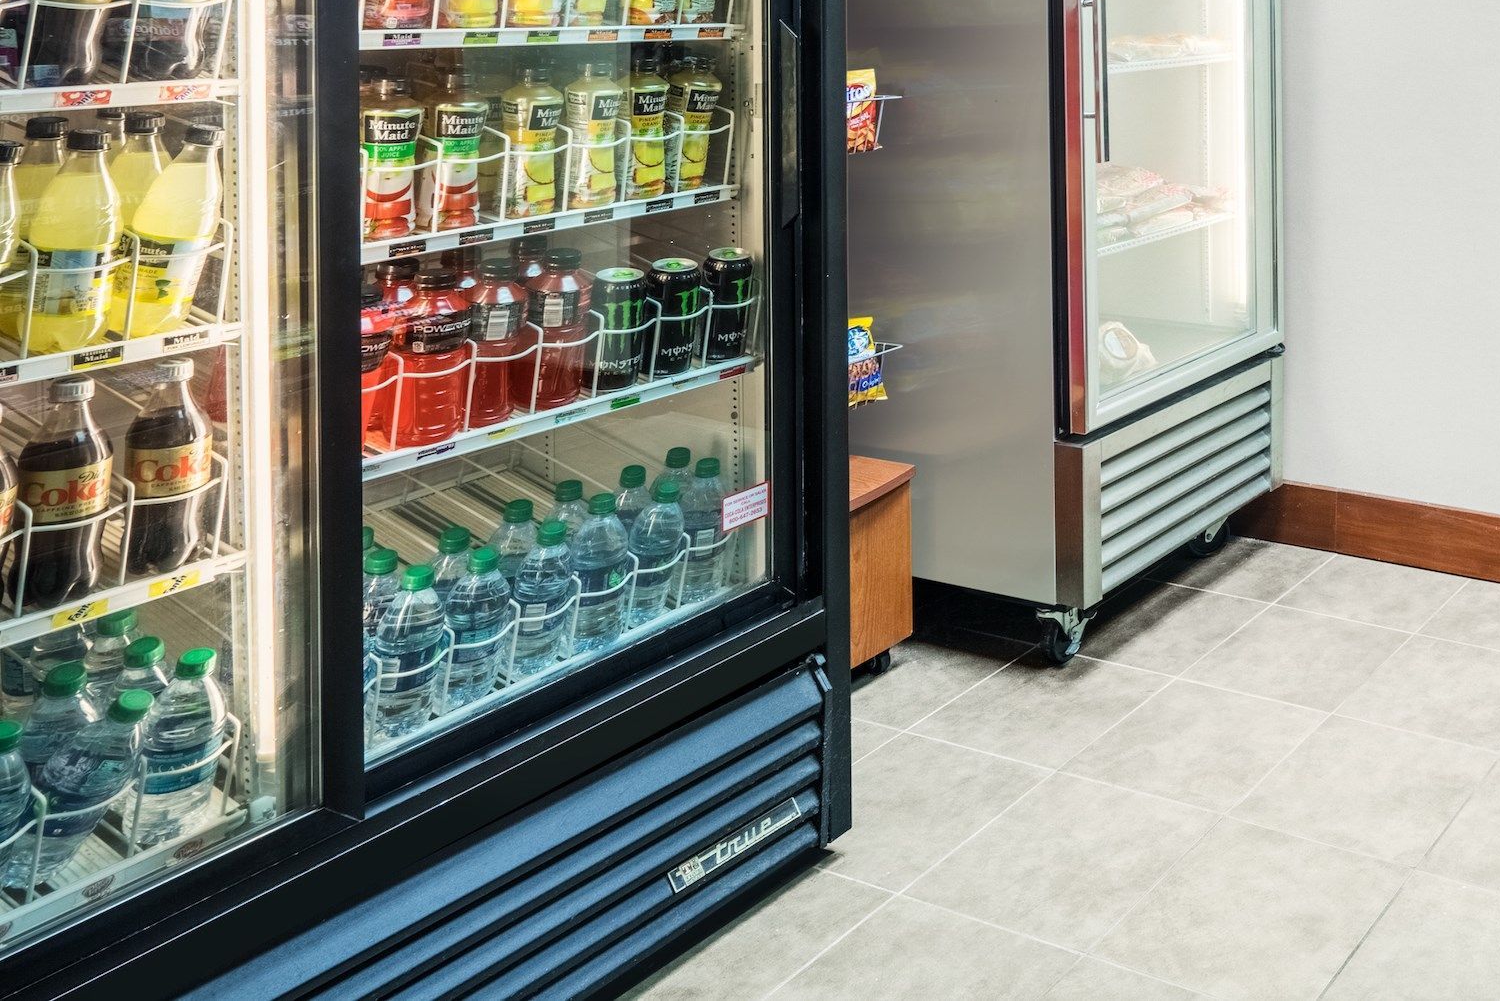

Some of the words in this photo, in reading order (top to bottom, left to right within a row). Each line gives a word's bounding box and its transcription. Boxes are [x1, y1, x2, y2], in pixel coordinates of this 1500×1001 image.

[369, 119, 415, 131] Minute
[442, 114, 483, 125] Minute
[374, 129, 409, 141] Maid
[447, 124, 478, 135] Maid
[84, 352, 109, 363] Maid
[23, 478, 106, 506] Coke
